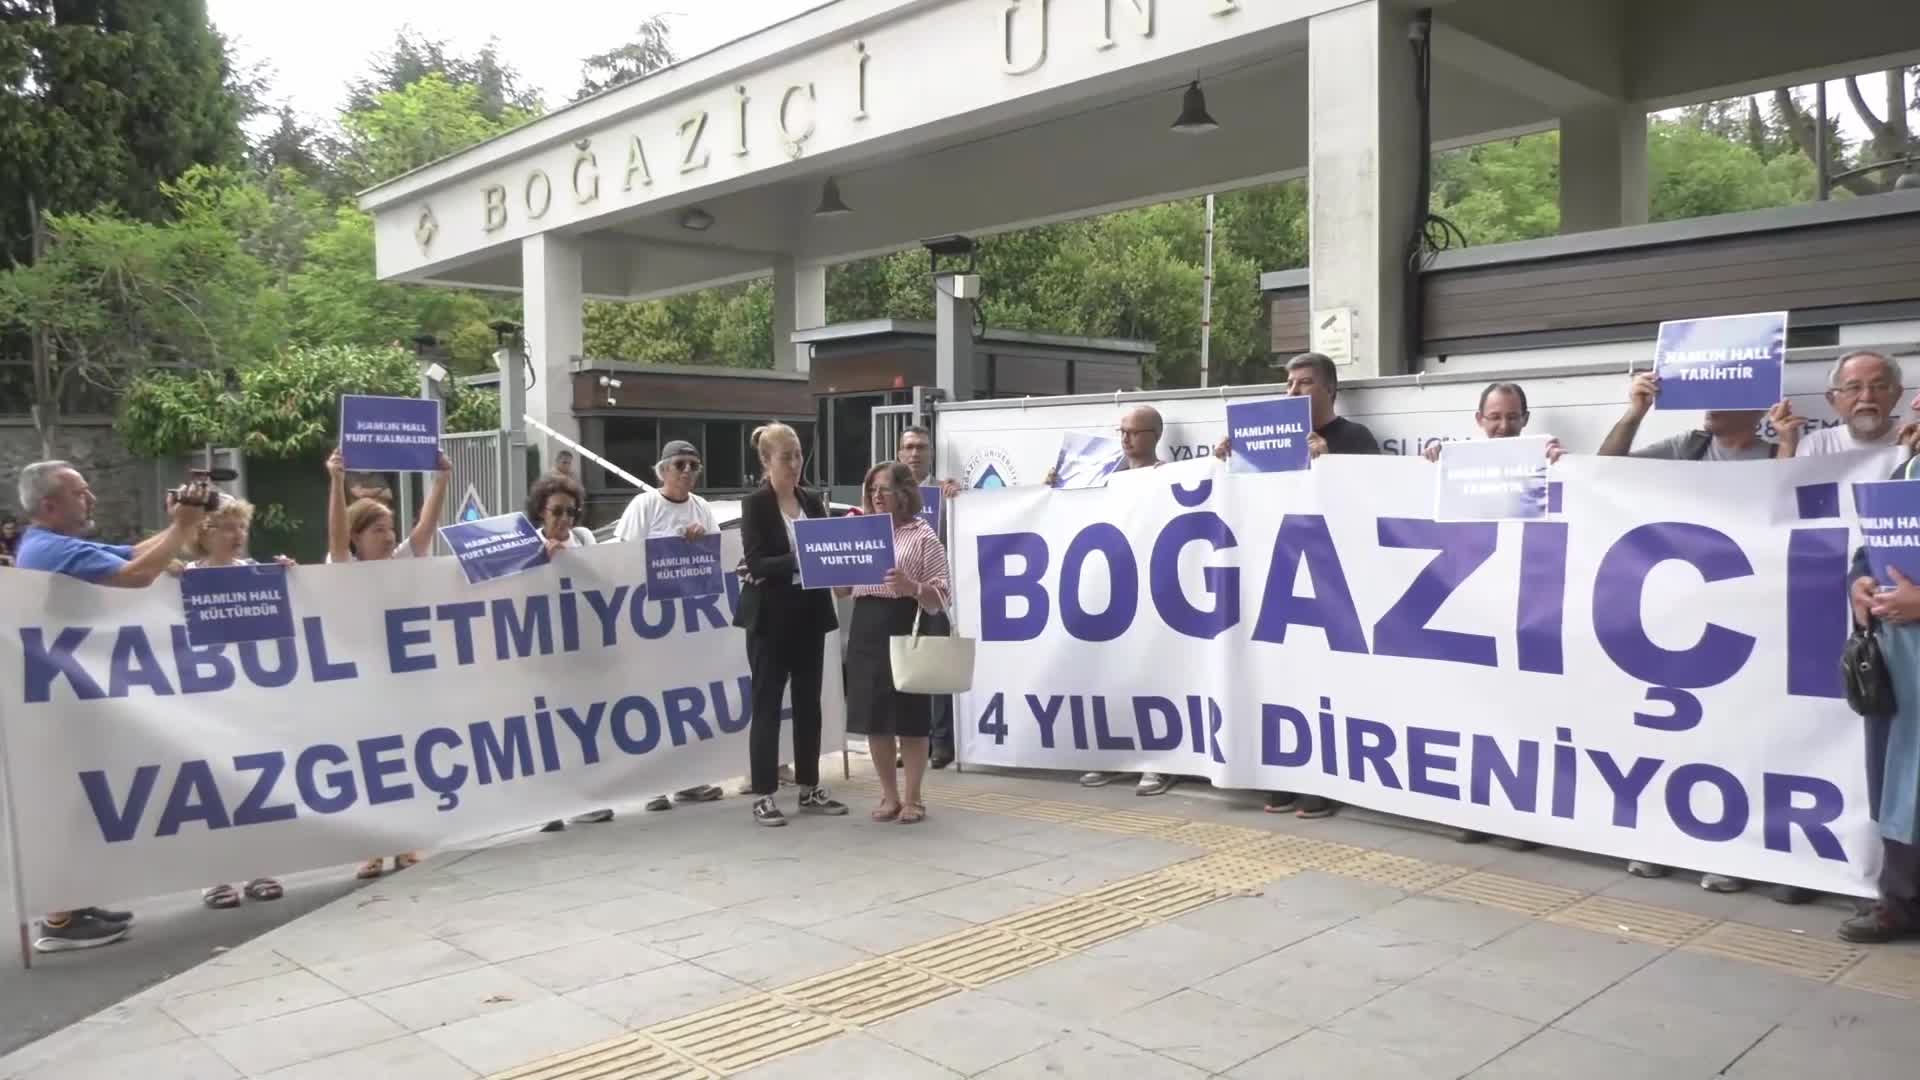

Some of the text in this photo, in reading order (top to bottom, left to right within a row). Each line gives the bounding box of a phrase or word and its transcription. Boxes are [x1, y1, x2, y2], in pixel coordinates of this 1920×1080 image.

[480, 38, 872, 235] BOĞAZİÇİ
[1731, 346, 1772, 360] HALL
[1680, 363, 1753, 381] TARİHTİR
[402, 423, 426, 432] HALL
[1234, 422, 1303, 439] HAMLIN HALL
[345, 433, 372, 443] YURT
[1245, 438, 1292, 451] YURTTUR
[805, 540, 886, 553] HAMLIN HALL
[460, 548, 486, 560] YURT
[820, 555, 873, 565] YURTTUR
[652, 555, 715, 568] HAMLIN HALL
[191, 589, 282, 605] HAMLIN HALL
[976, 479, 1850, 731] BOĞAZİÇİ
[19, 615, 358, 703] KABUL
[978, 693, 1008, 745] 4
[1261, 696, 1848, 863] DİRENİYOR
